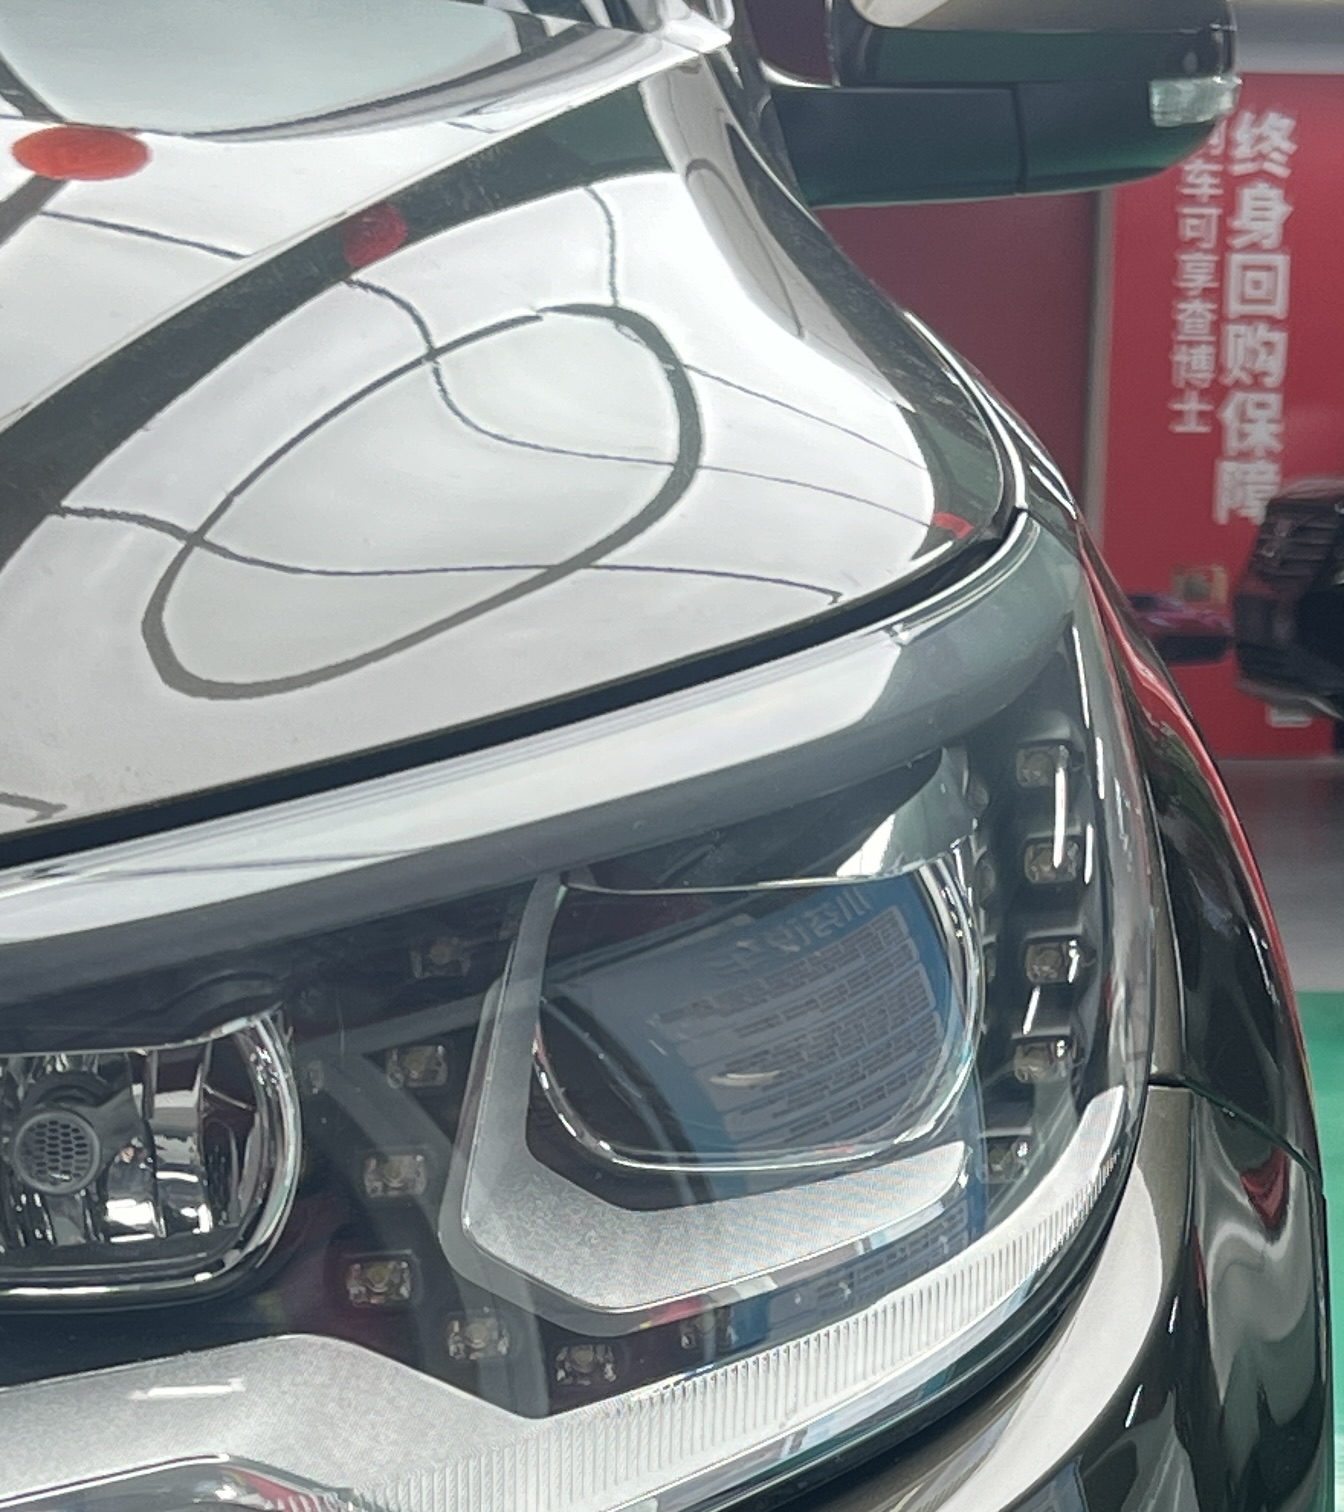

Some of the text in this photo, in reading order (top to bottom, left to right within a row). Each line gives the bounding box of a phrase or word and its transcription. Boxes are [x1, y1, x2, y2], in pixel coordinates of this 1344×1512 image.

[1212, 111, 1298, 526] 终身回购保障
